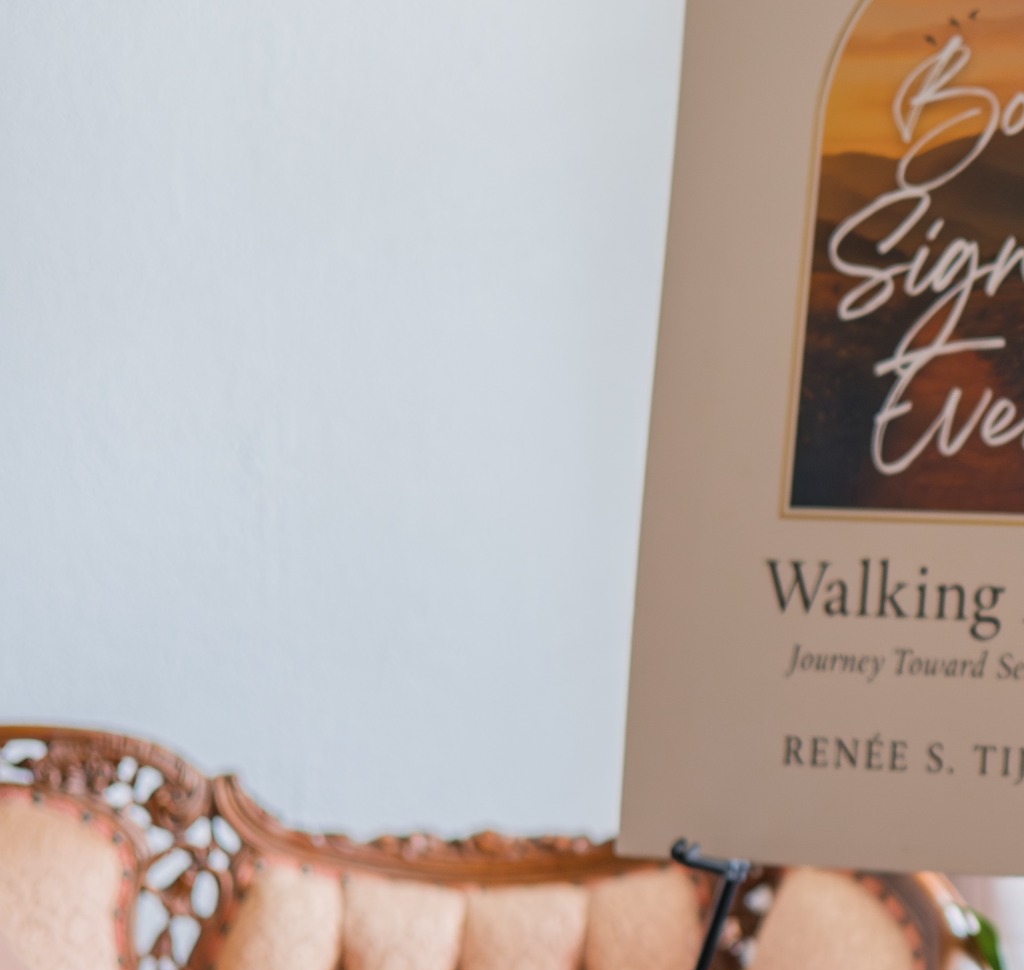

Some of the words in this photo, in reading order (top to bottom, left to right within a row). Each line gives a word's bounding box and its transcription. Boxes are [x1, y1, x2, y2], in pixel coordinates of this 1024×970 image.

[765, 557, 1006, 641] Walking
[785, 643, 886, 683] Journey
[893, 647, 990, 680] Toward
[782, 732, 909, 773] RENÉE
[925, 742, 955, 776] S.
